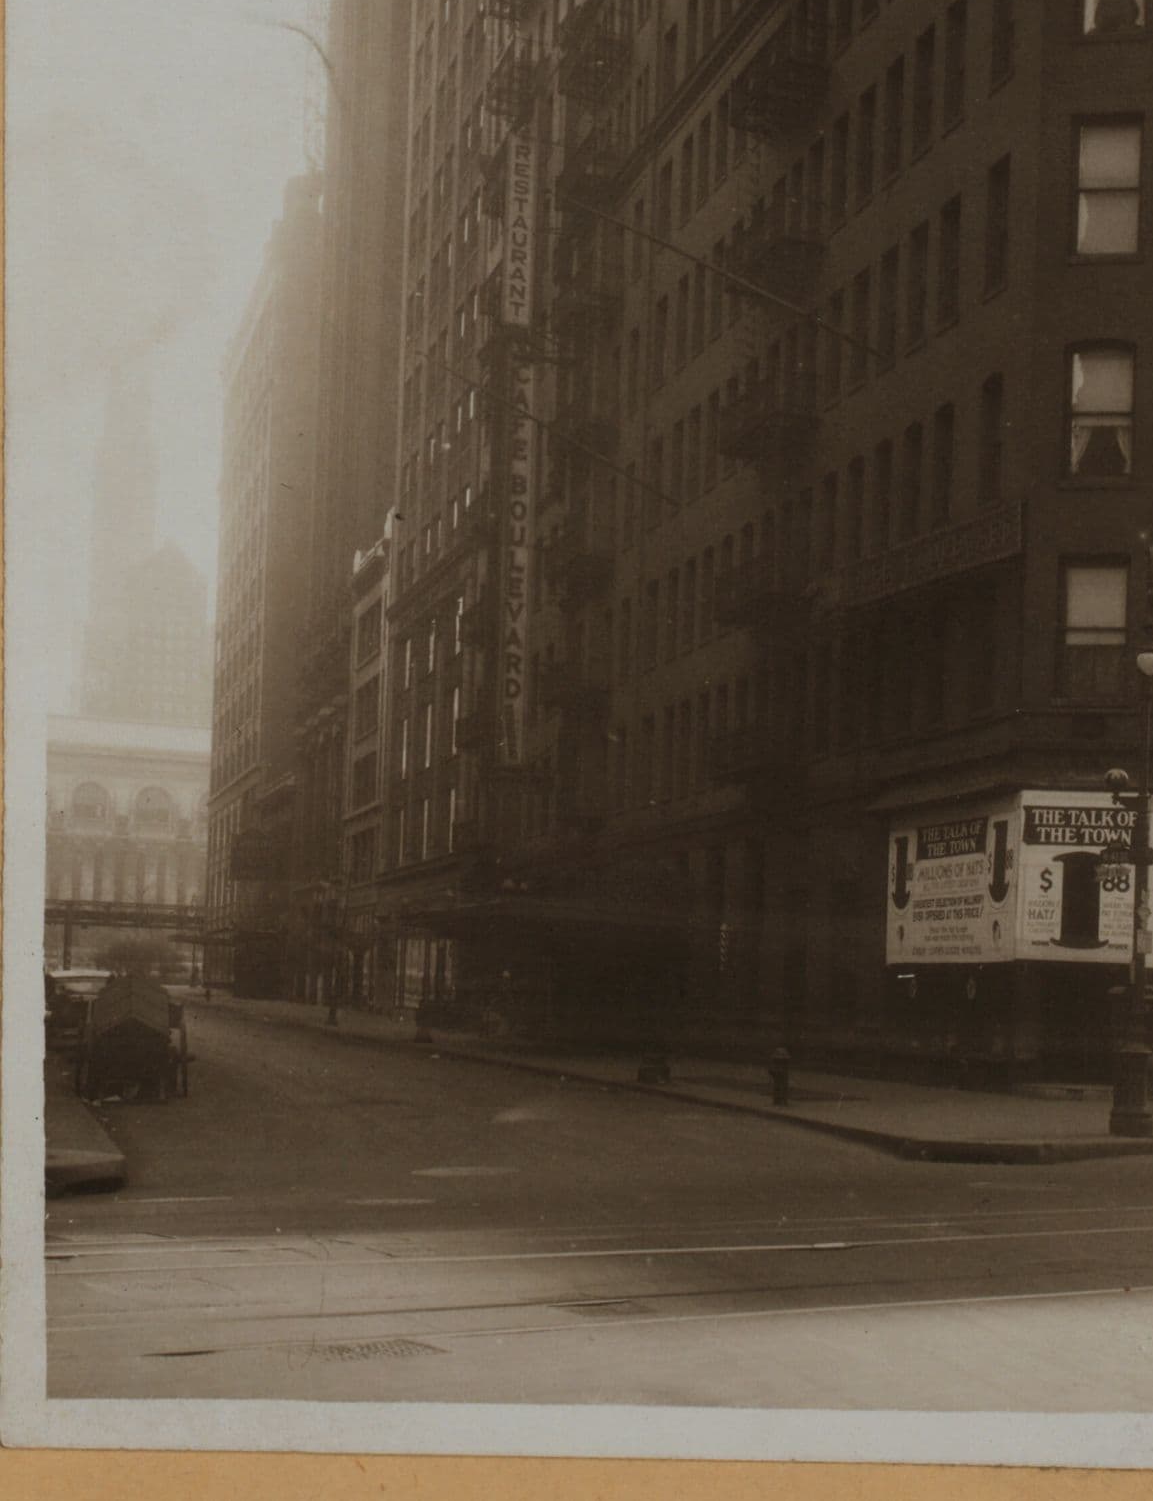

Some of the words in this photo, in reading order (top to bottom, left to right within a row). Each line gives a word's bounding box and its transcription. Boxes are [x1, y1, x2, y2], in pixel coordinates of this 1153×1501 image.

[509, 144, 530, 317] RESTAURANT
[505, 474, 527, 698] BOULEVARD
[1031, 809, 1065, 825] THE
[1068, 810, 1114, 827] TALK
[1117, 811, 1138, 827] OF
[1037, 827, 1077, 842] THE
[1080, 828, 1132, 845] TOWN
[928, 842, 945, 858] THE
